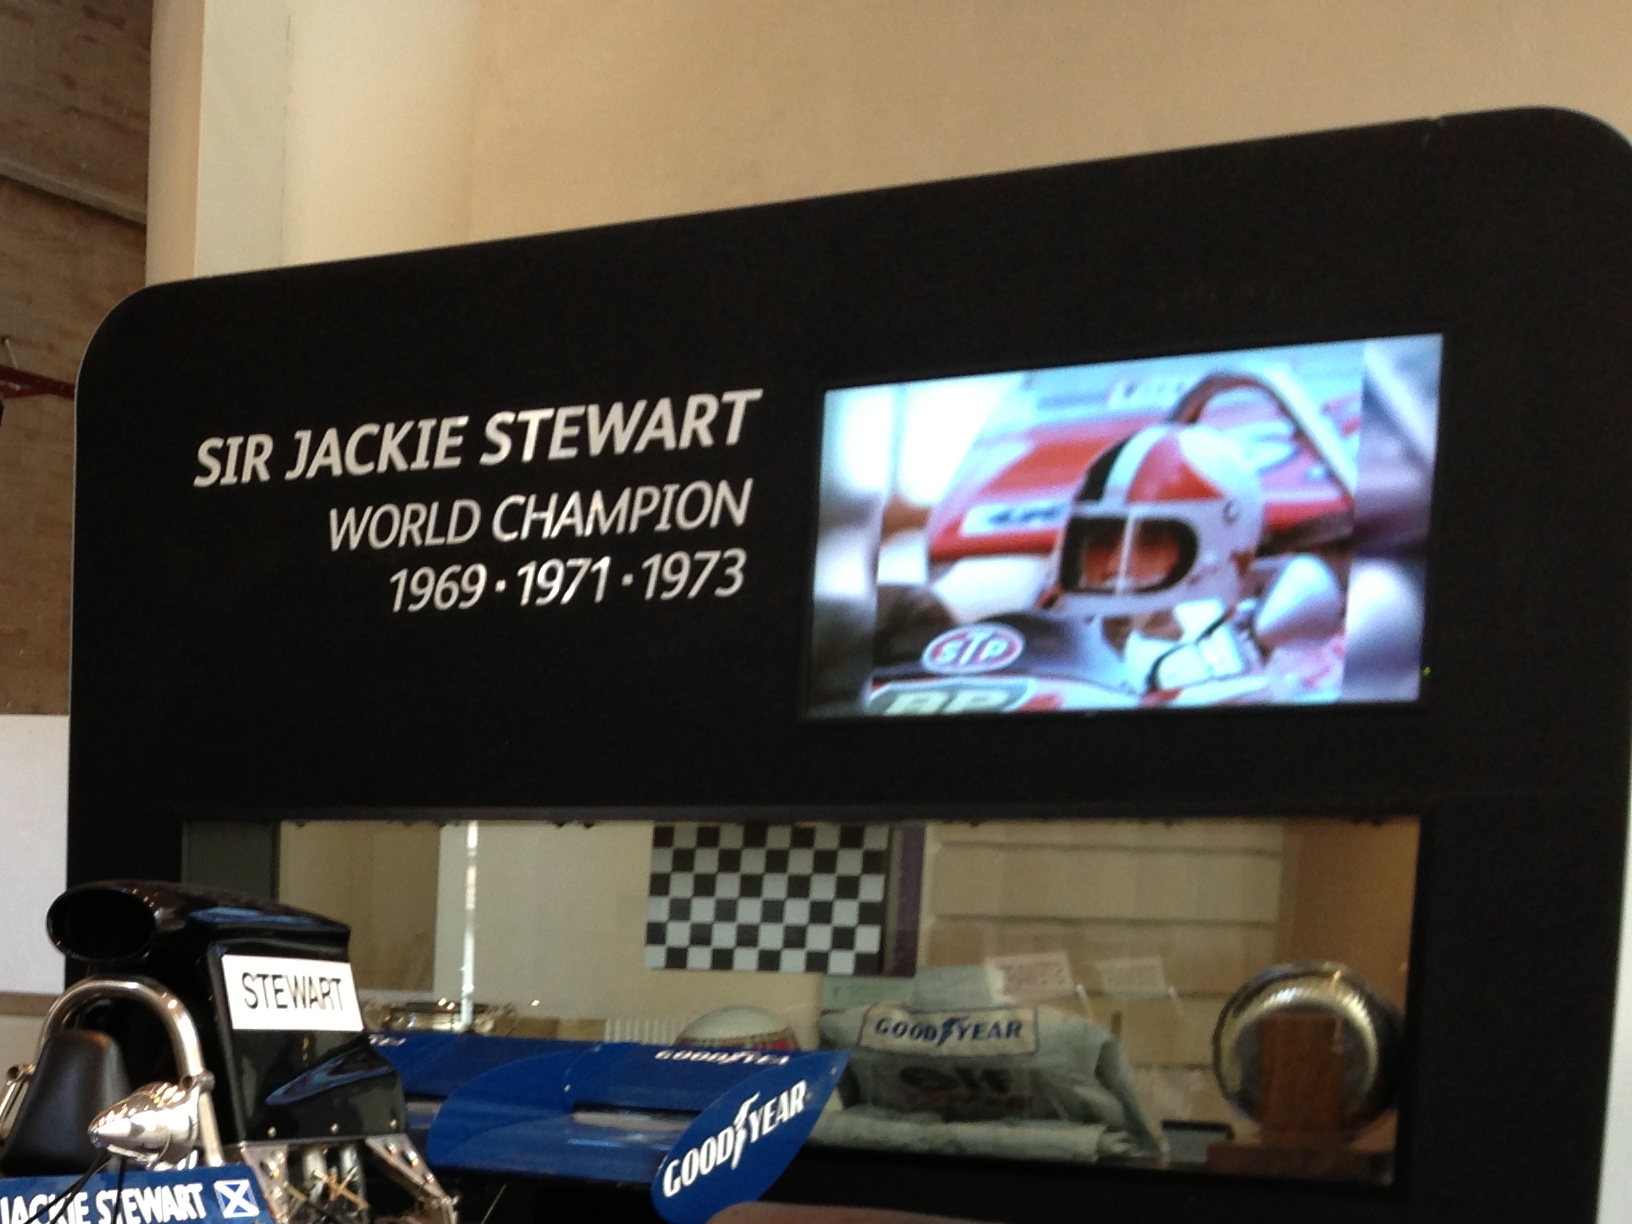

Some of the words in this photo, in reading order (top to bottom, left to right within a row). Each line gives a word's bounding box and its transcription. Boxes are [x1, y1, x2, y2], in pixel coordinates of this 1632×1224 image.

[193, 434, 274, 487] SIR
[283, 416, 468, 481] JACKIE
[480, 388, 763, 465] STEWART
[329, 498, 481, 552] WORLD
[491, 477, 753, 542] CHAMPION
[242, 972, 343, 1011] STEWART
[663, 1080, 807, 1197] GOODYEAR
